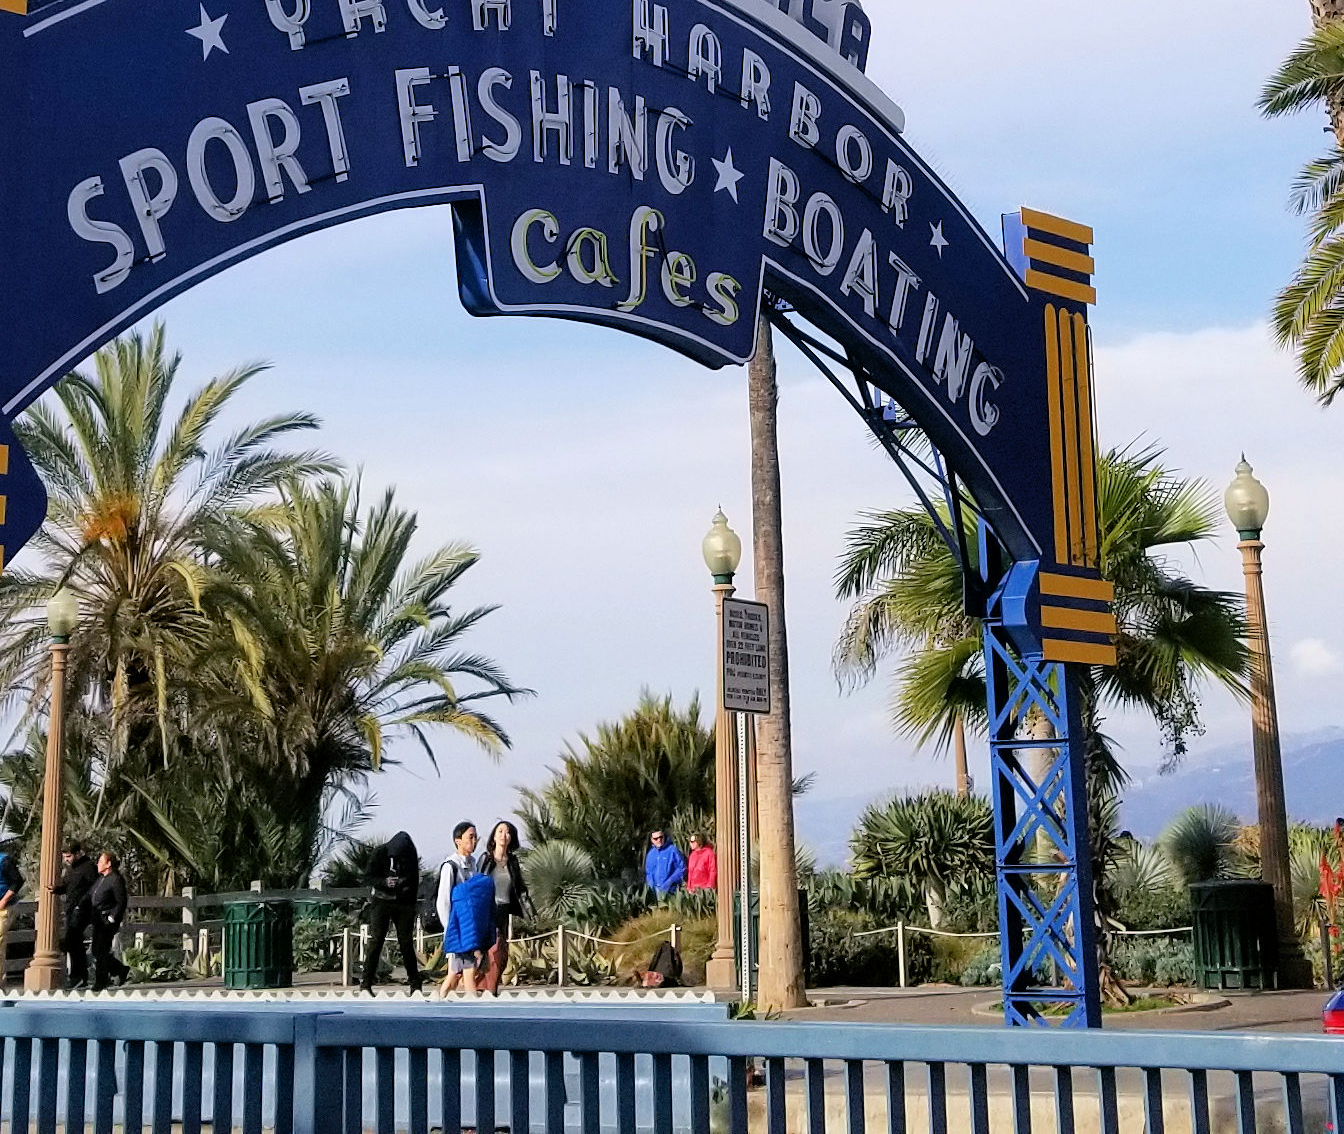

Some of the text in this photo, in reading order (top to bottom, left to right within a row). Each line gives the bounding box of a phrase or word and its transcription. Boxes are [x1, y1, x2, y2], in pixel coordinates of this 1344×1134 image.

[66, 65, 1005, 437] SPORT FISHING BOATING
[726, 650, 767, 669] PROHIBITED
